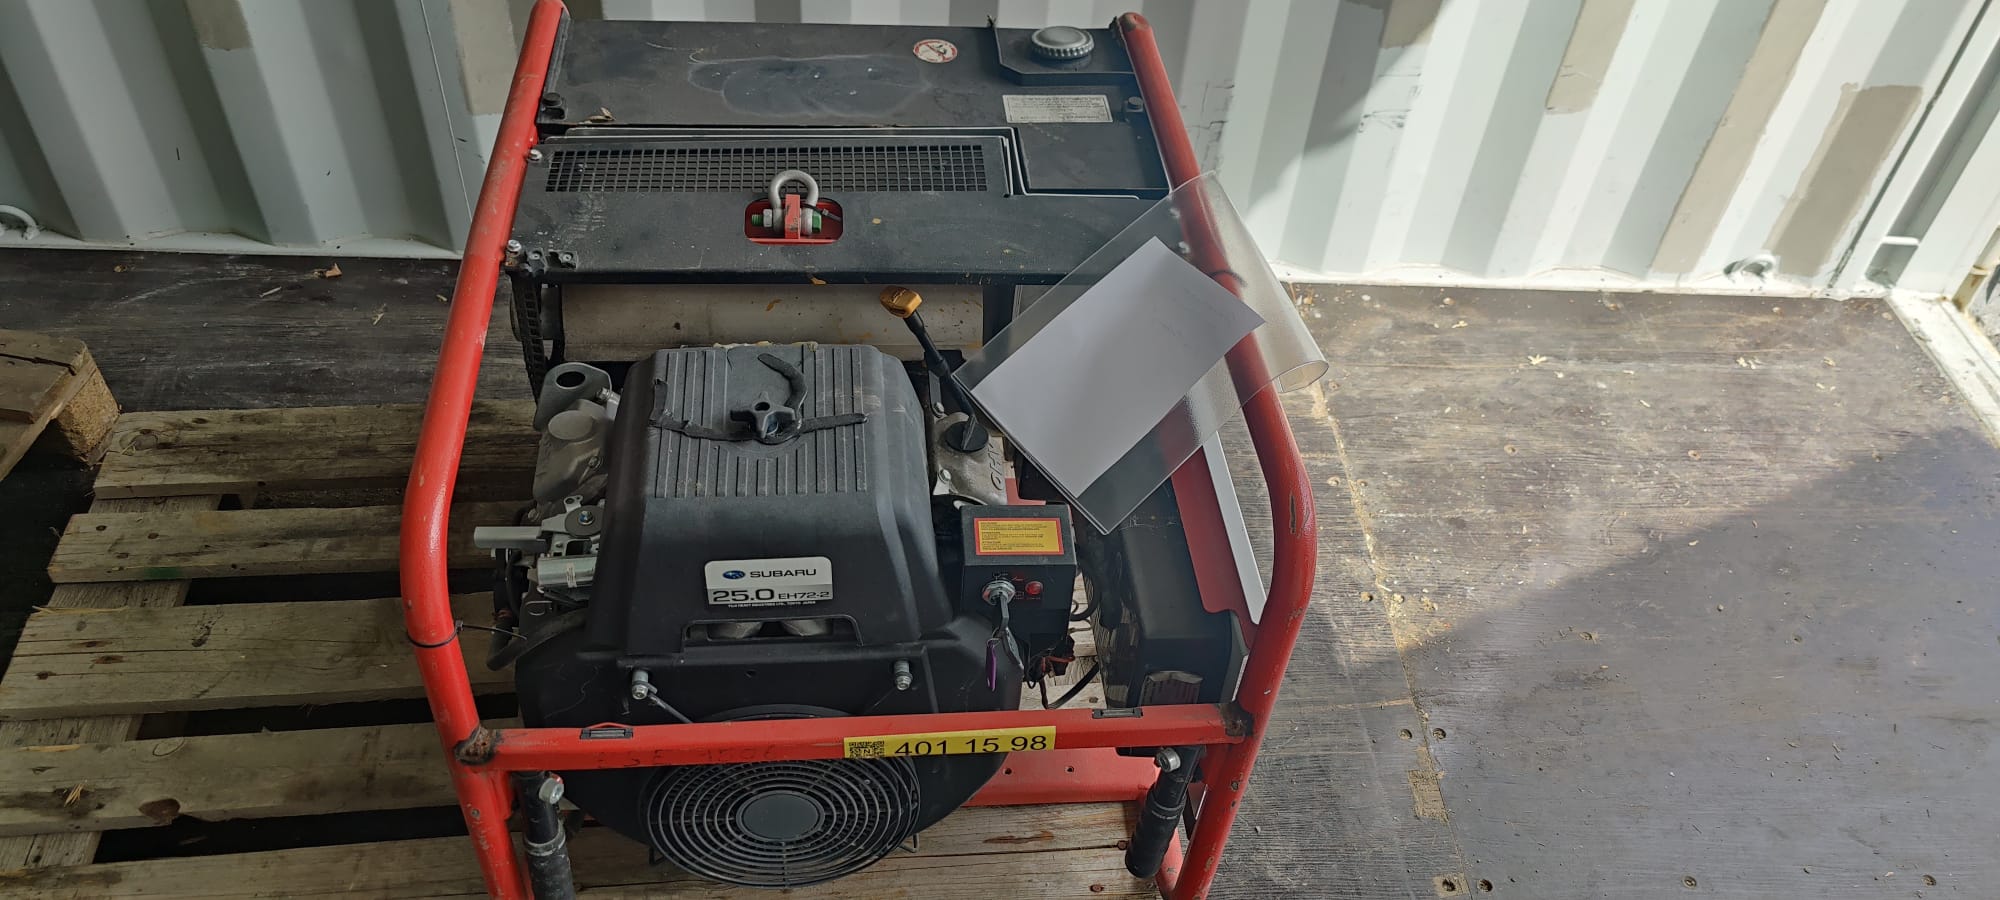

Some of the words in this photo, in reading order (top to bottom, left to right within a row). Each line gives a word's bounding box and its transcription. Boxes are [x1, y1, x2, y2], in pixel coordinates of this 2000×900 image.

[750, 569, 816, 578] SUBARU
[713, 589, 774, 602] 25.0
[778, 591, 829, 600] EH72-2
[894, 740, 949, 757] 401
[965, 738, 1000, 753] 15
[1011, 735, 1047, 751] 98
